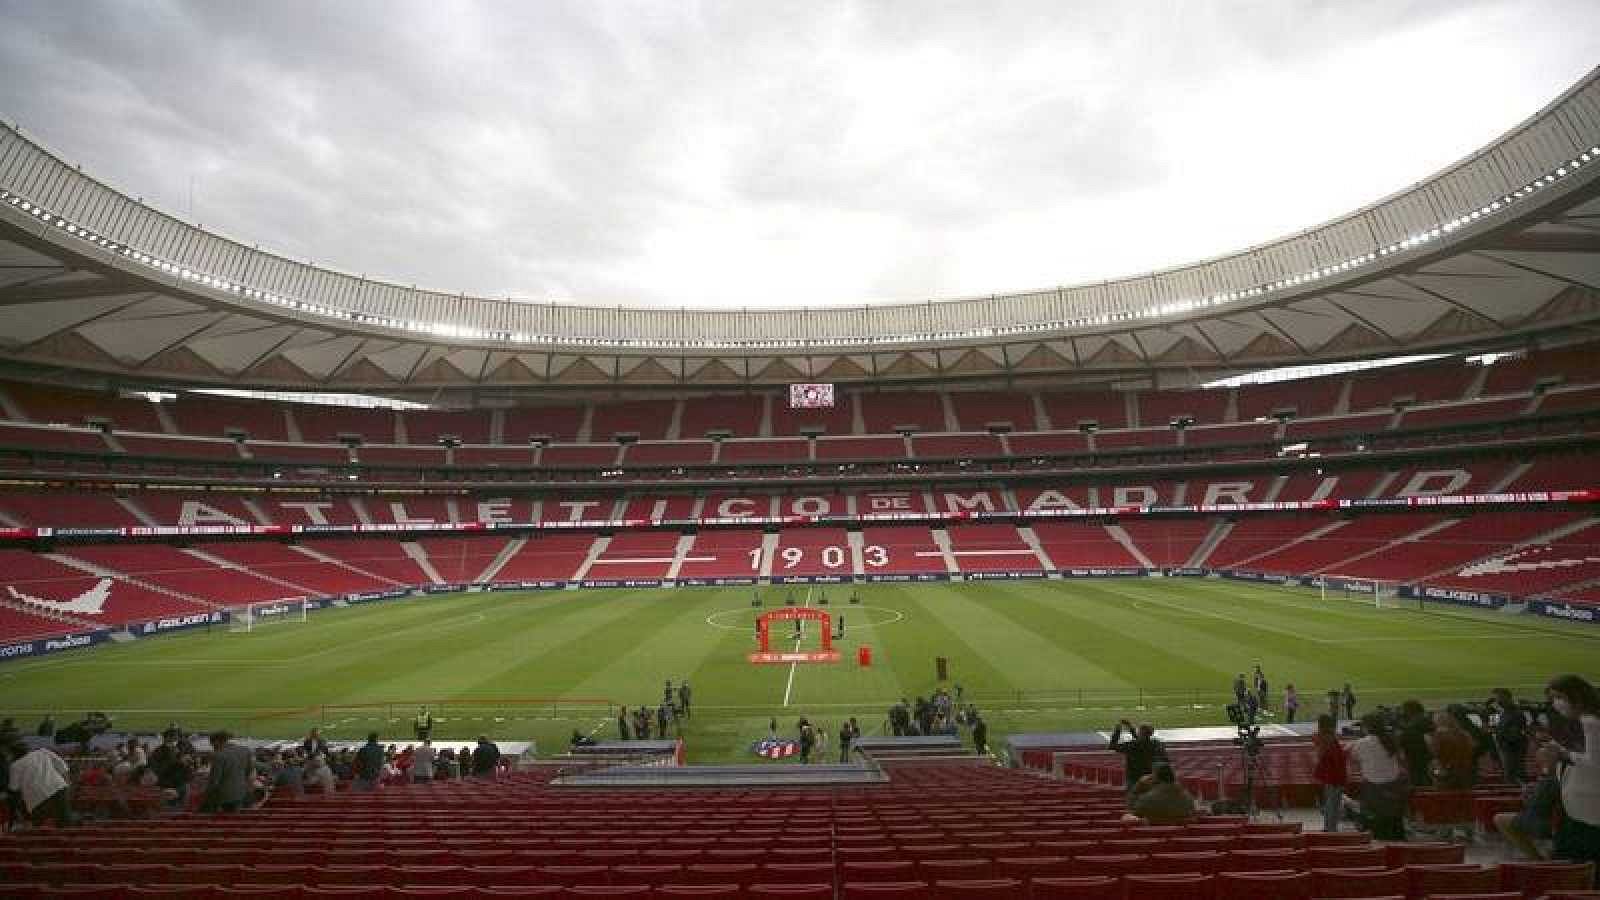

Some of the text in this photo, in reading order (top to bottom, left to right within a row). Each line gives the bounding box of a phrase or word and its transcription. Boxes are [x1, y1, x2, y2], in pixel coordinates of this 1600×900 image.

[870, 498, 912, 509] DE
[944, 468, 1473, 512] MADRID
[750, 544, 889, 569] 1903
